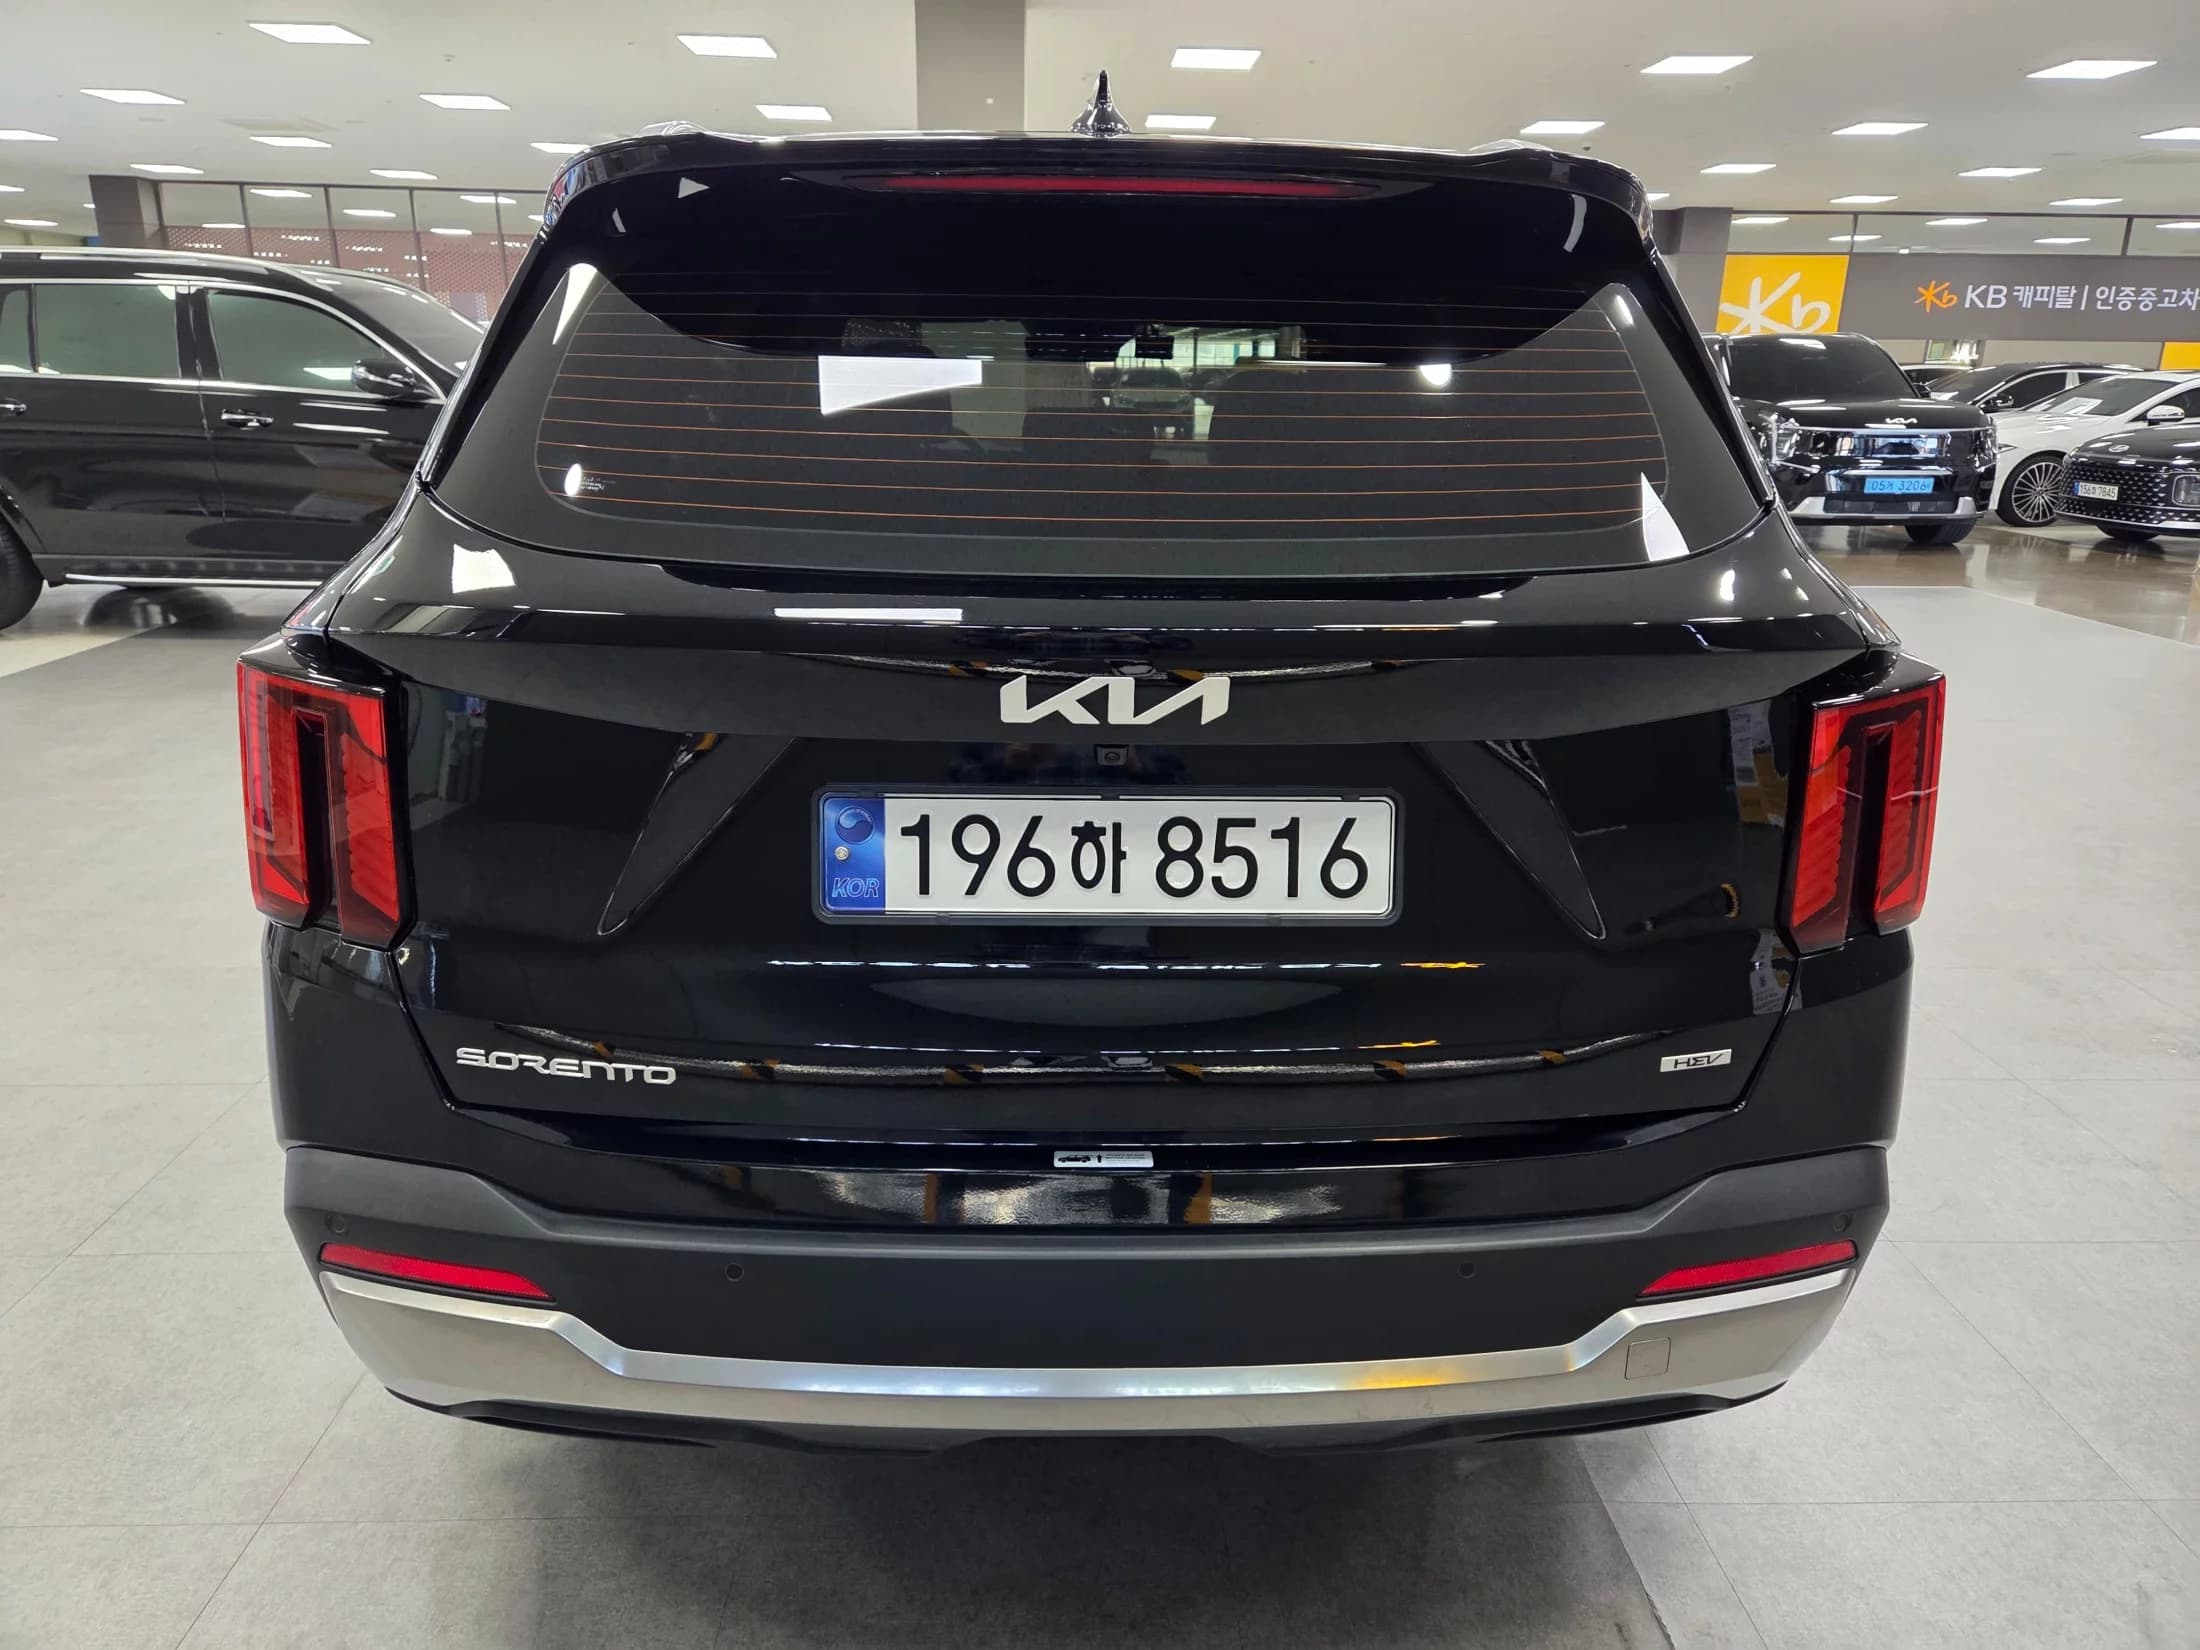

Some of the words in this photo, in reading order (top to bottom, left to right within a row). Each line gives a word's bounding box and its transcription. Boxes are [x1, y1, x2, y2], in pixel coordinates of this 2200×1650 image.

[1964, 284, 2008, 309] KB
[2012, 285, 2077, 309] 캐피탈
[2095, 286, 2200, 311] 인증중고차
[1000, 675, 1230, 725] KIA
[901, 814, 1126, 897] 196하
[1155, 816, 1369, 899] 8516
[832, 877, 880, 898] KOR
[456, 1047, 676, 1085] SORENTO
[1674, 1053, 1725, 1069] HEV
